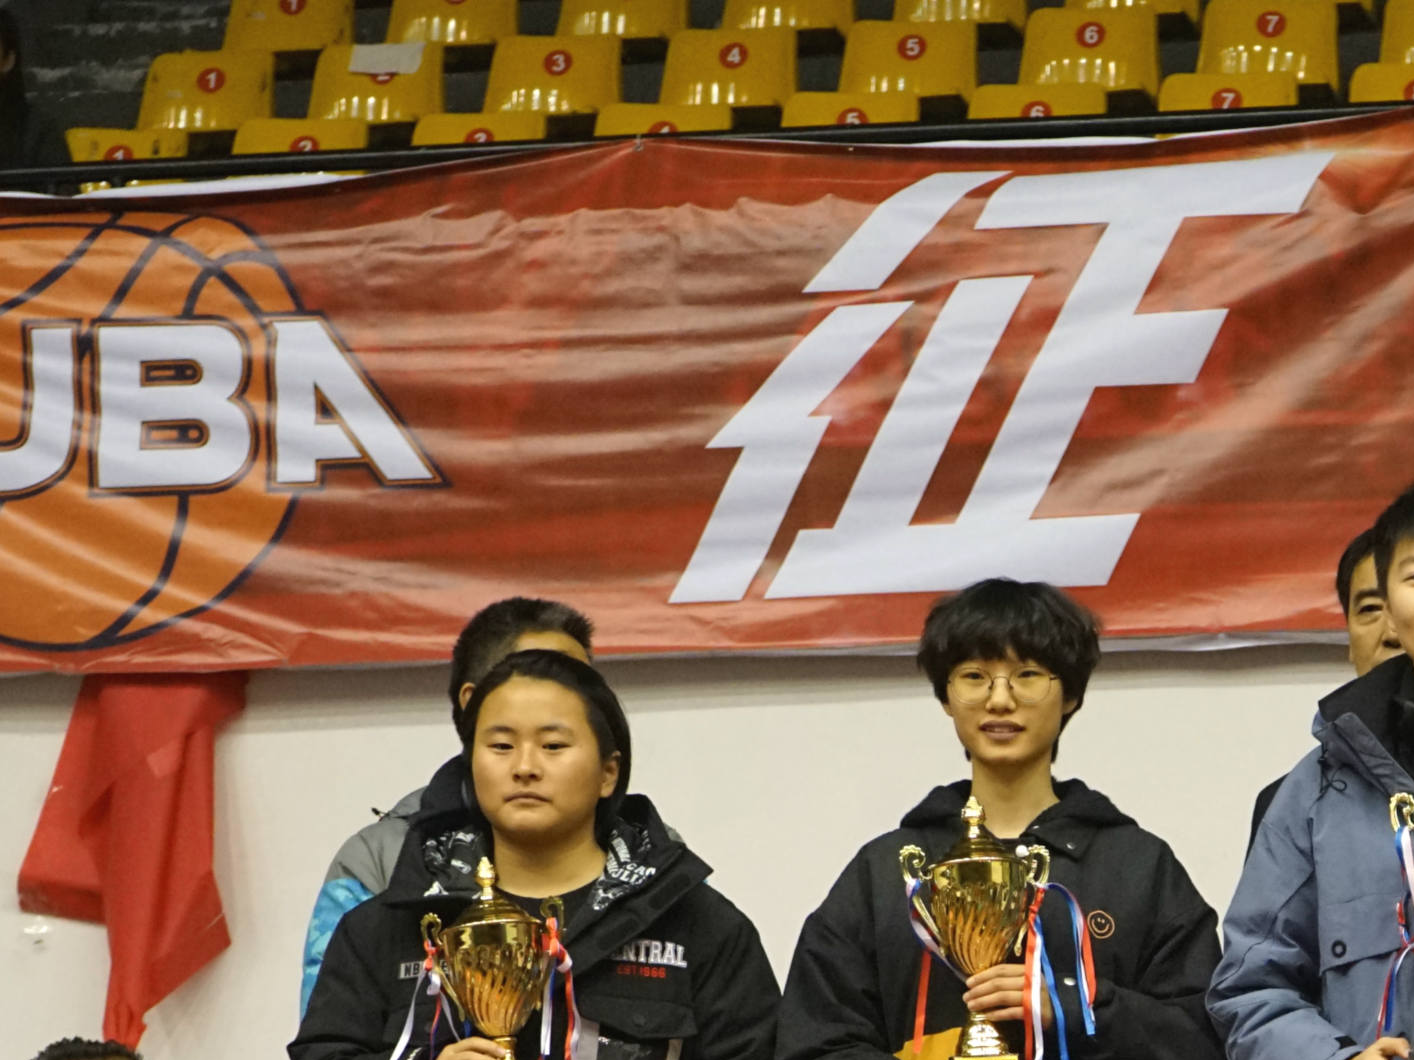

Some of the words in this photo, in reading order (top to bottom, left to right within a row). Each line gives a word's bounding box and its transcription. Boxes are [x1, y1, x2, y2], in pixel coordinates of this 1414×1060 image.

[1264, 14, 1281, 33] 7
[1083, 25, 1099, 44] 6
[726, 46, 741, 64] 4
[905, 38, 921, 56] 5
[551, 53, 565, 72] 3
[1220, 92, 1236, 109] 7
